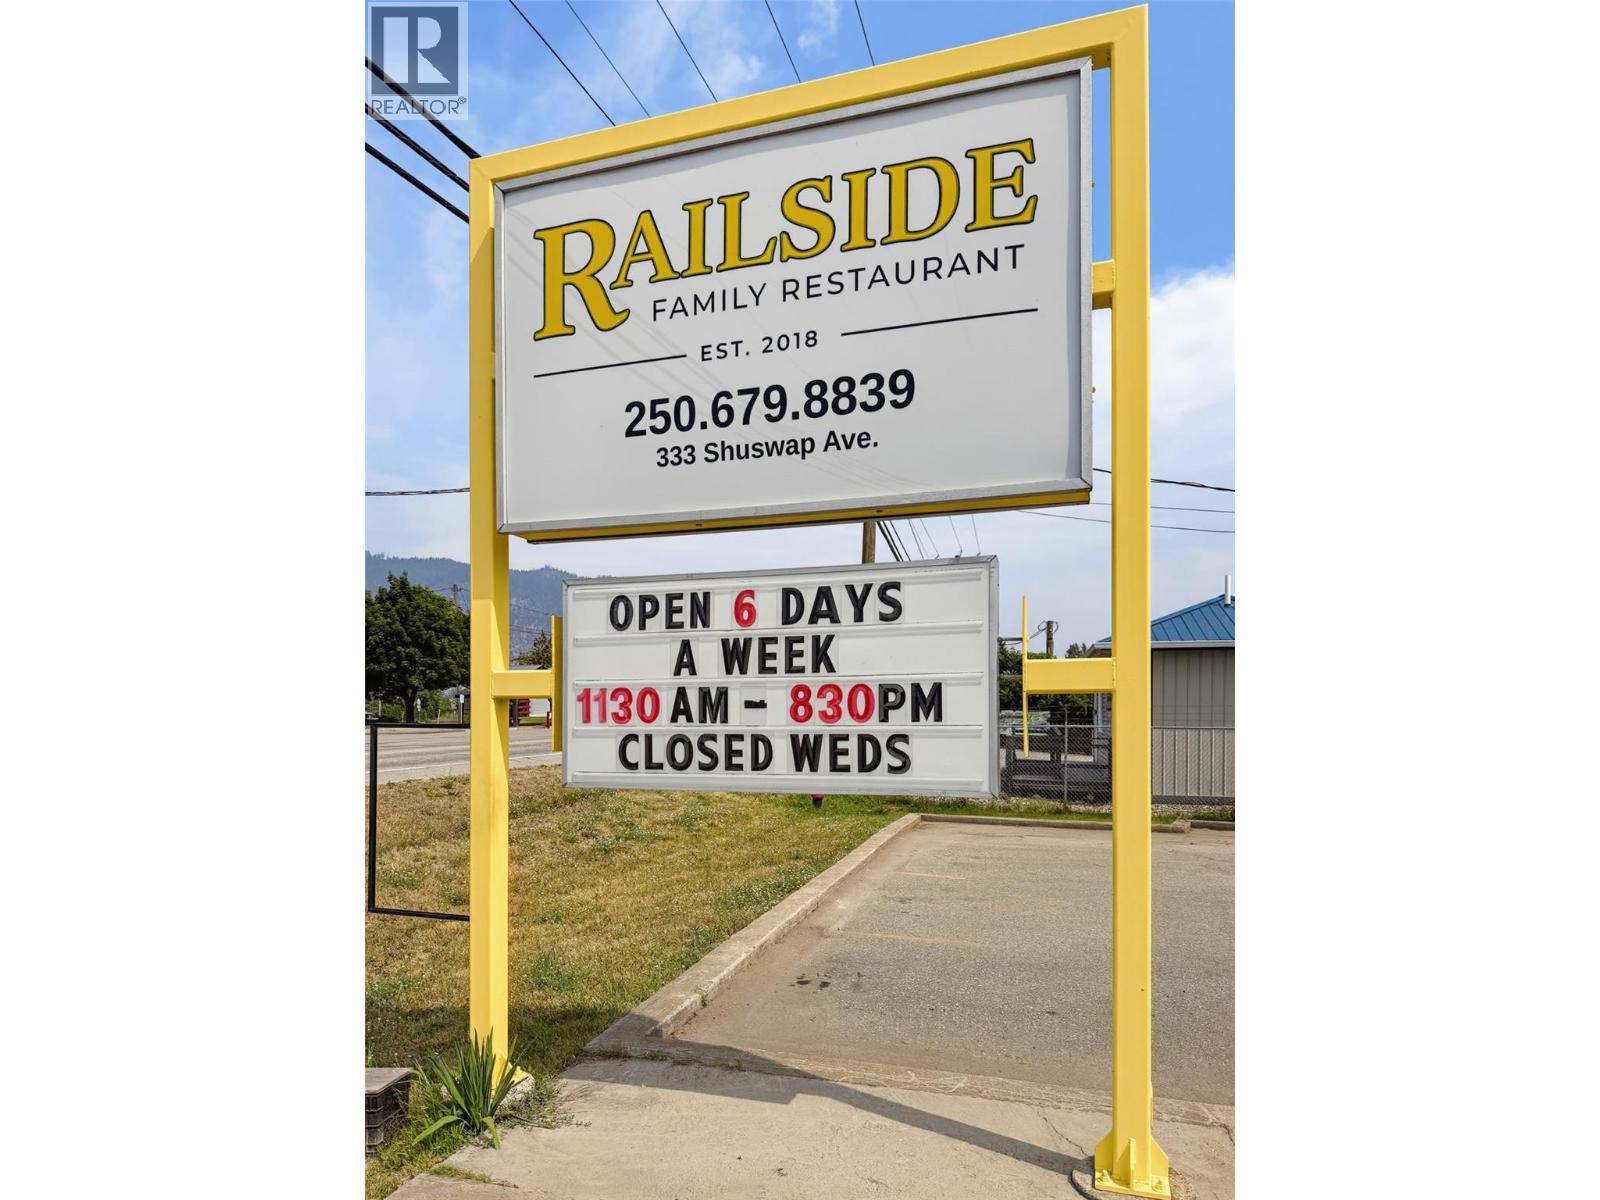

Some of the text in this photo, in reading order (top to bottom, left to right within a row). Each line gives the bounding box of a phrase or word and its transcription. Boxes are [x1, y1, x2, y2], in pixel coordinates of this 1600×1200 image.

[533, 138, 1038, 341] RAILSIDE
[652, 244, 1025, 322] FAMILY RESTAURANT
[700, 330, 819, 362] EST. 2018
[624, 368, 916, 438] 250.679.8839
[656, 429, 879, 468] 333 Shuswap Ave.
[609, 581, 903, 631] OPEN 6 DAYS
[673, 634, 837, 677] A WEEK
[618, 733, 912, 775] CLOSED WEDS
